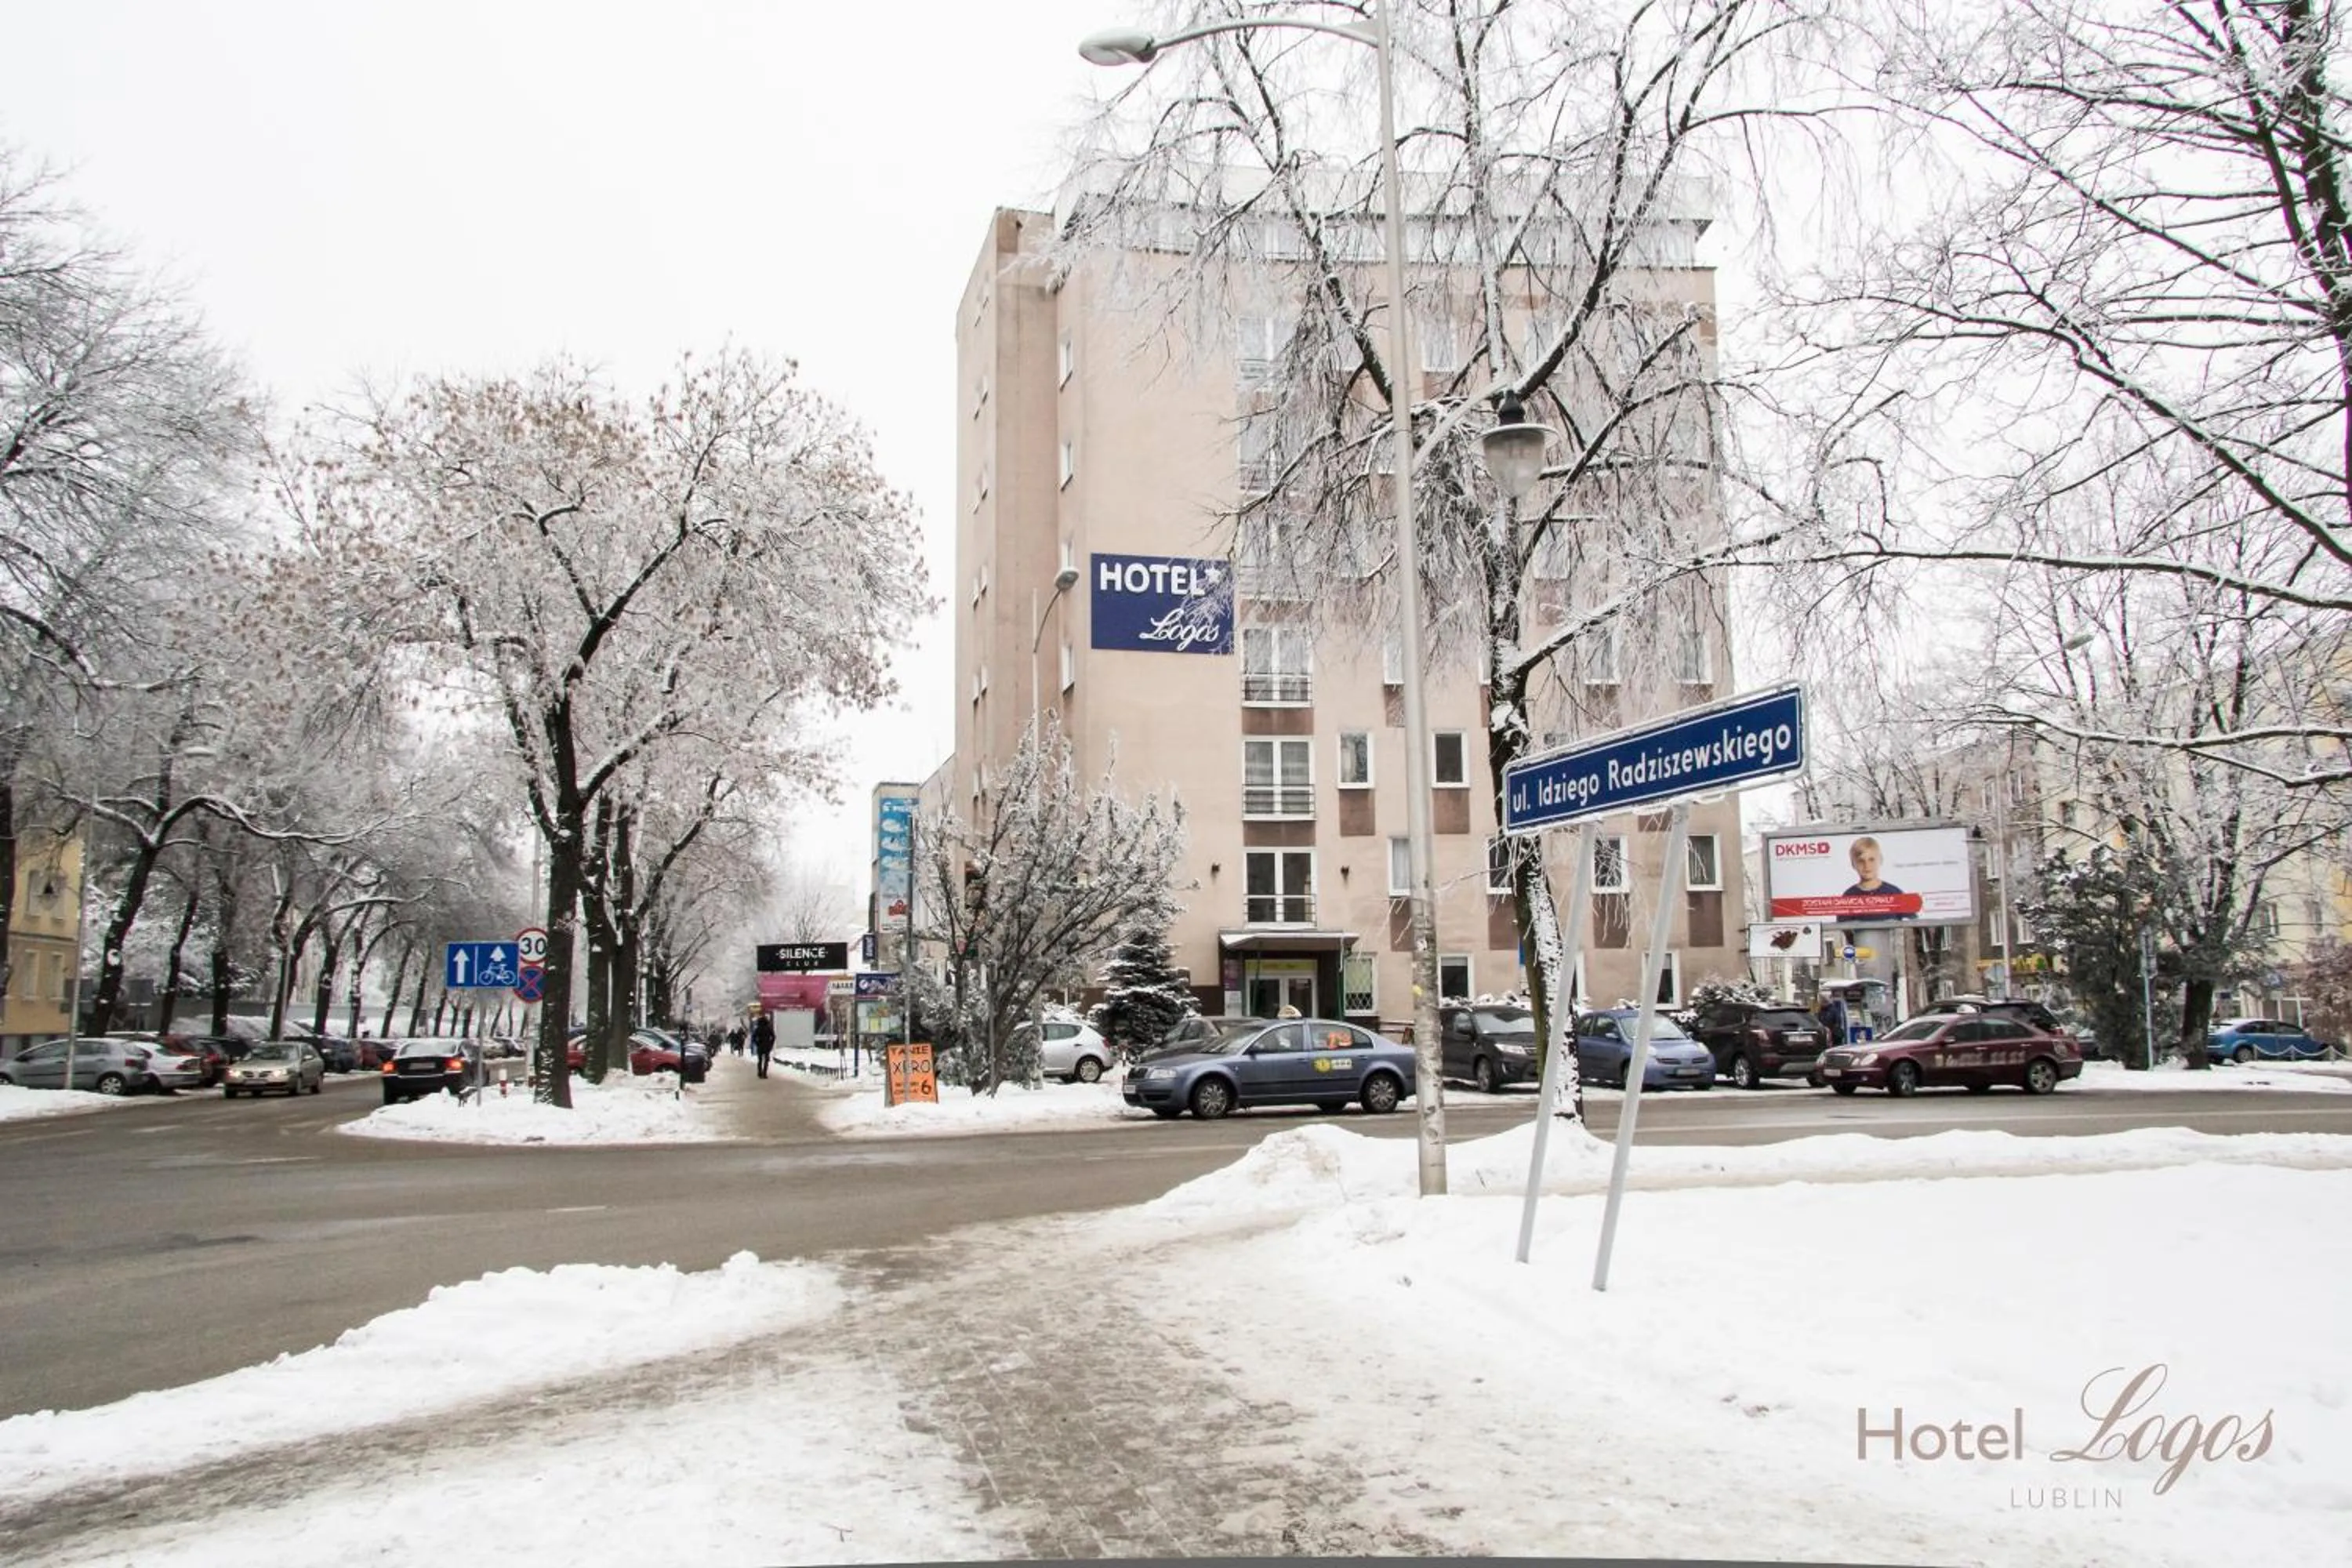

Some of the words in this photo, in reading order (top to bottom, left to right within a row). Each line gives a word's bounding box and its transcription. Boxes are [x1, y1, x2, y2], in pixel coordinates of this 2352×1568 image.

[1100, 563, 1206, 597] HOTEL
[1139, 608, 1221, 652] Logos
[1512, 787, 1531, 813] ul.
[1537, 773, 1600, 807] Idziego
[1608, 724, 1791, 791] Radziszewskiego
[1775, 843, 1817, 856] DKMS
[521, 937, 546, 955] 30
[779, 946, 826, 960] SILENCE
